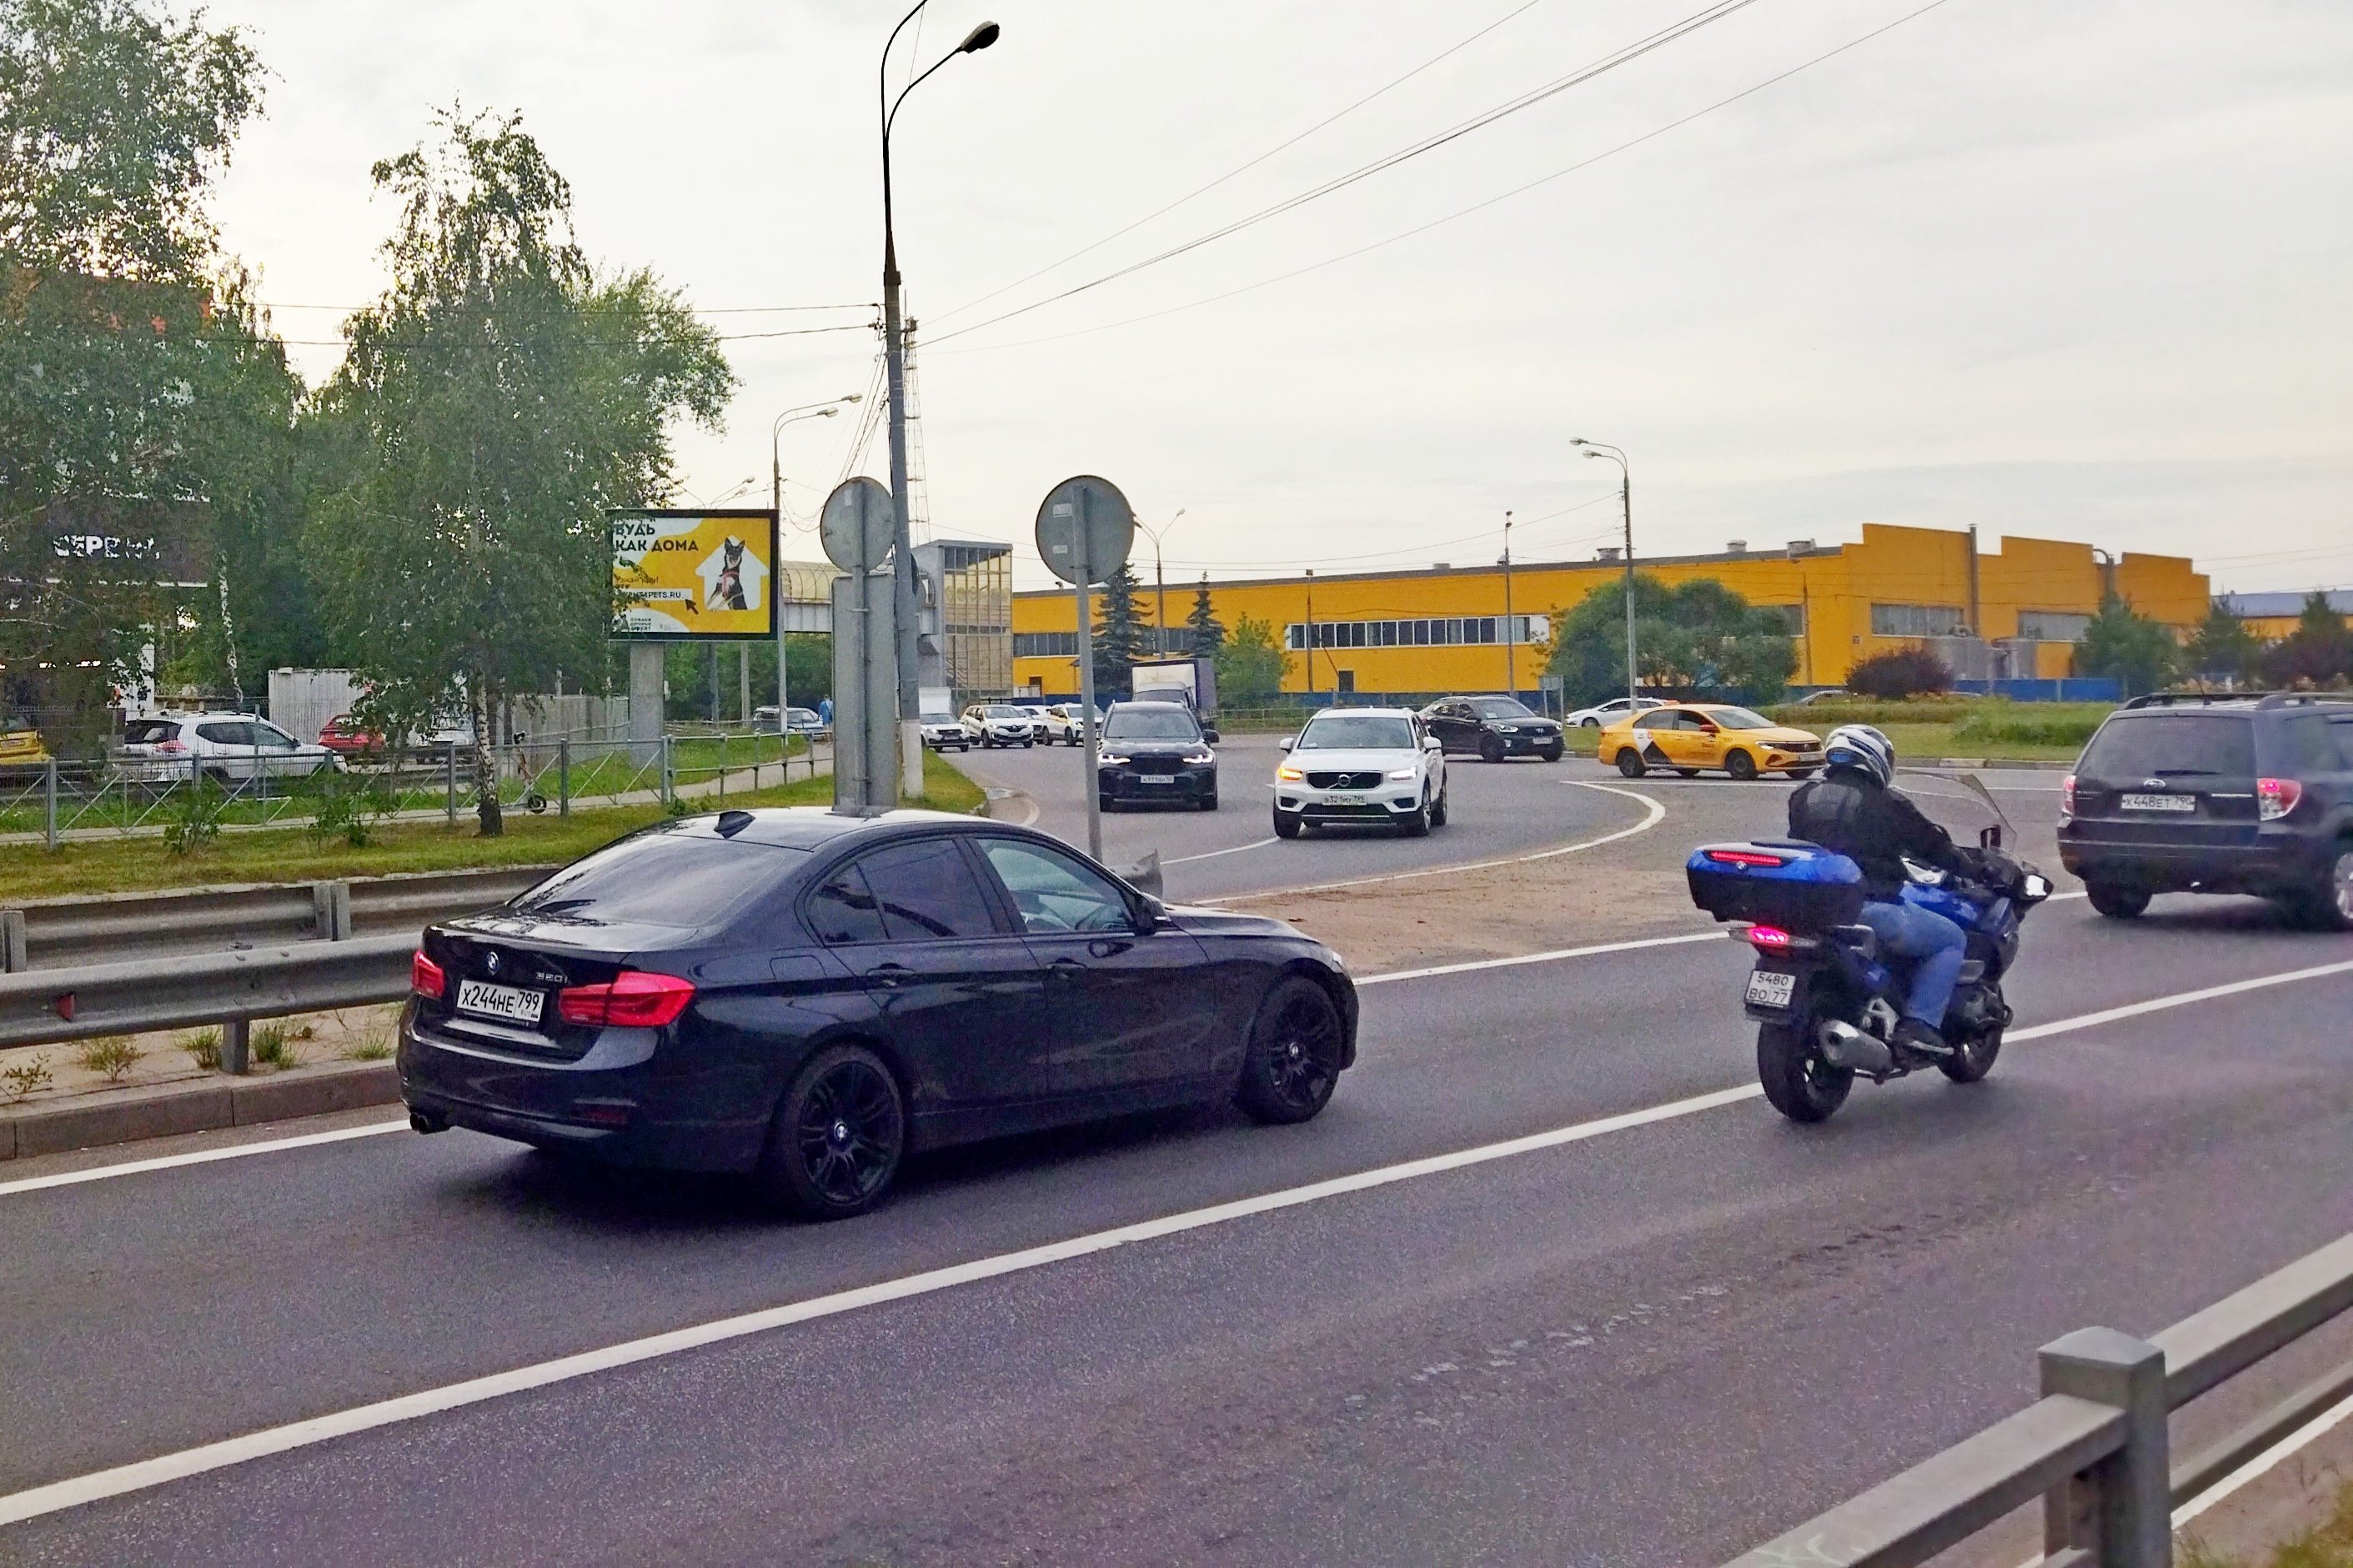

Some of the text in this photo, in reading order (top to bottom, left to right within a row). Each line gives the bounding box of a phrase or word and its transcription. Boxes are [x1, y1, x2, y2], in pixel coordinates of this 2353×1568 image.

[615, 539, 699, 552] КАК ДОМА
[1758, 973, 1789, 986] 5480
[518, 991, 539, 1010] 799
[1773, 991, 1788, 1003] 77
